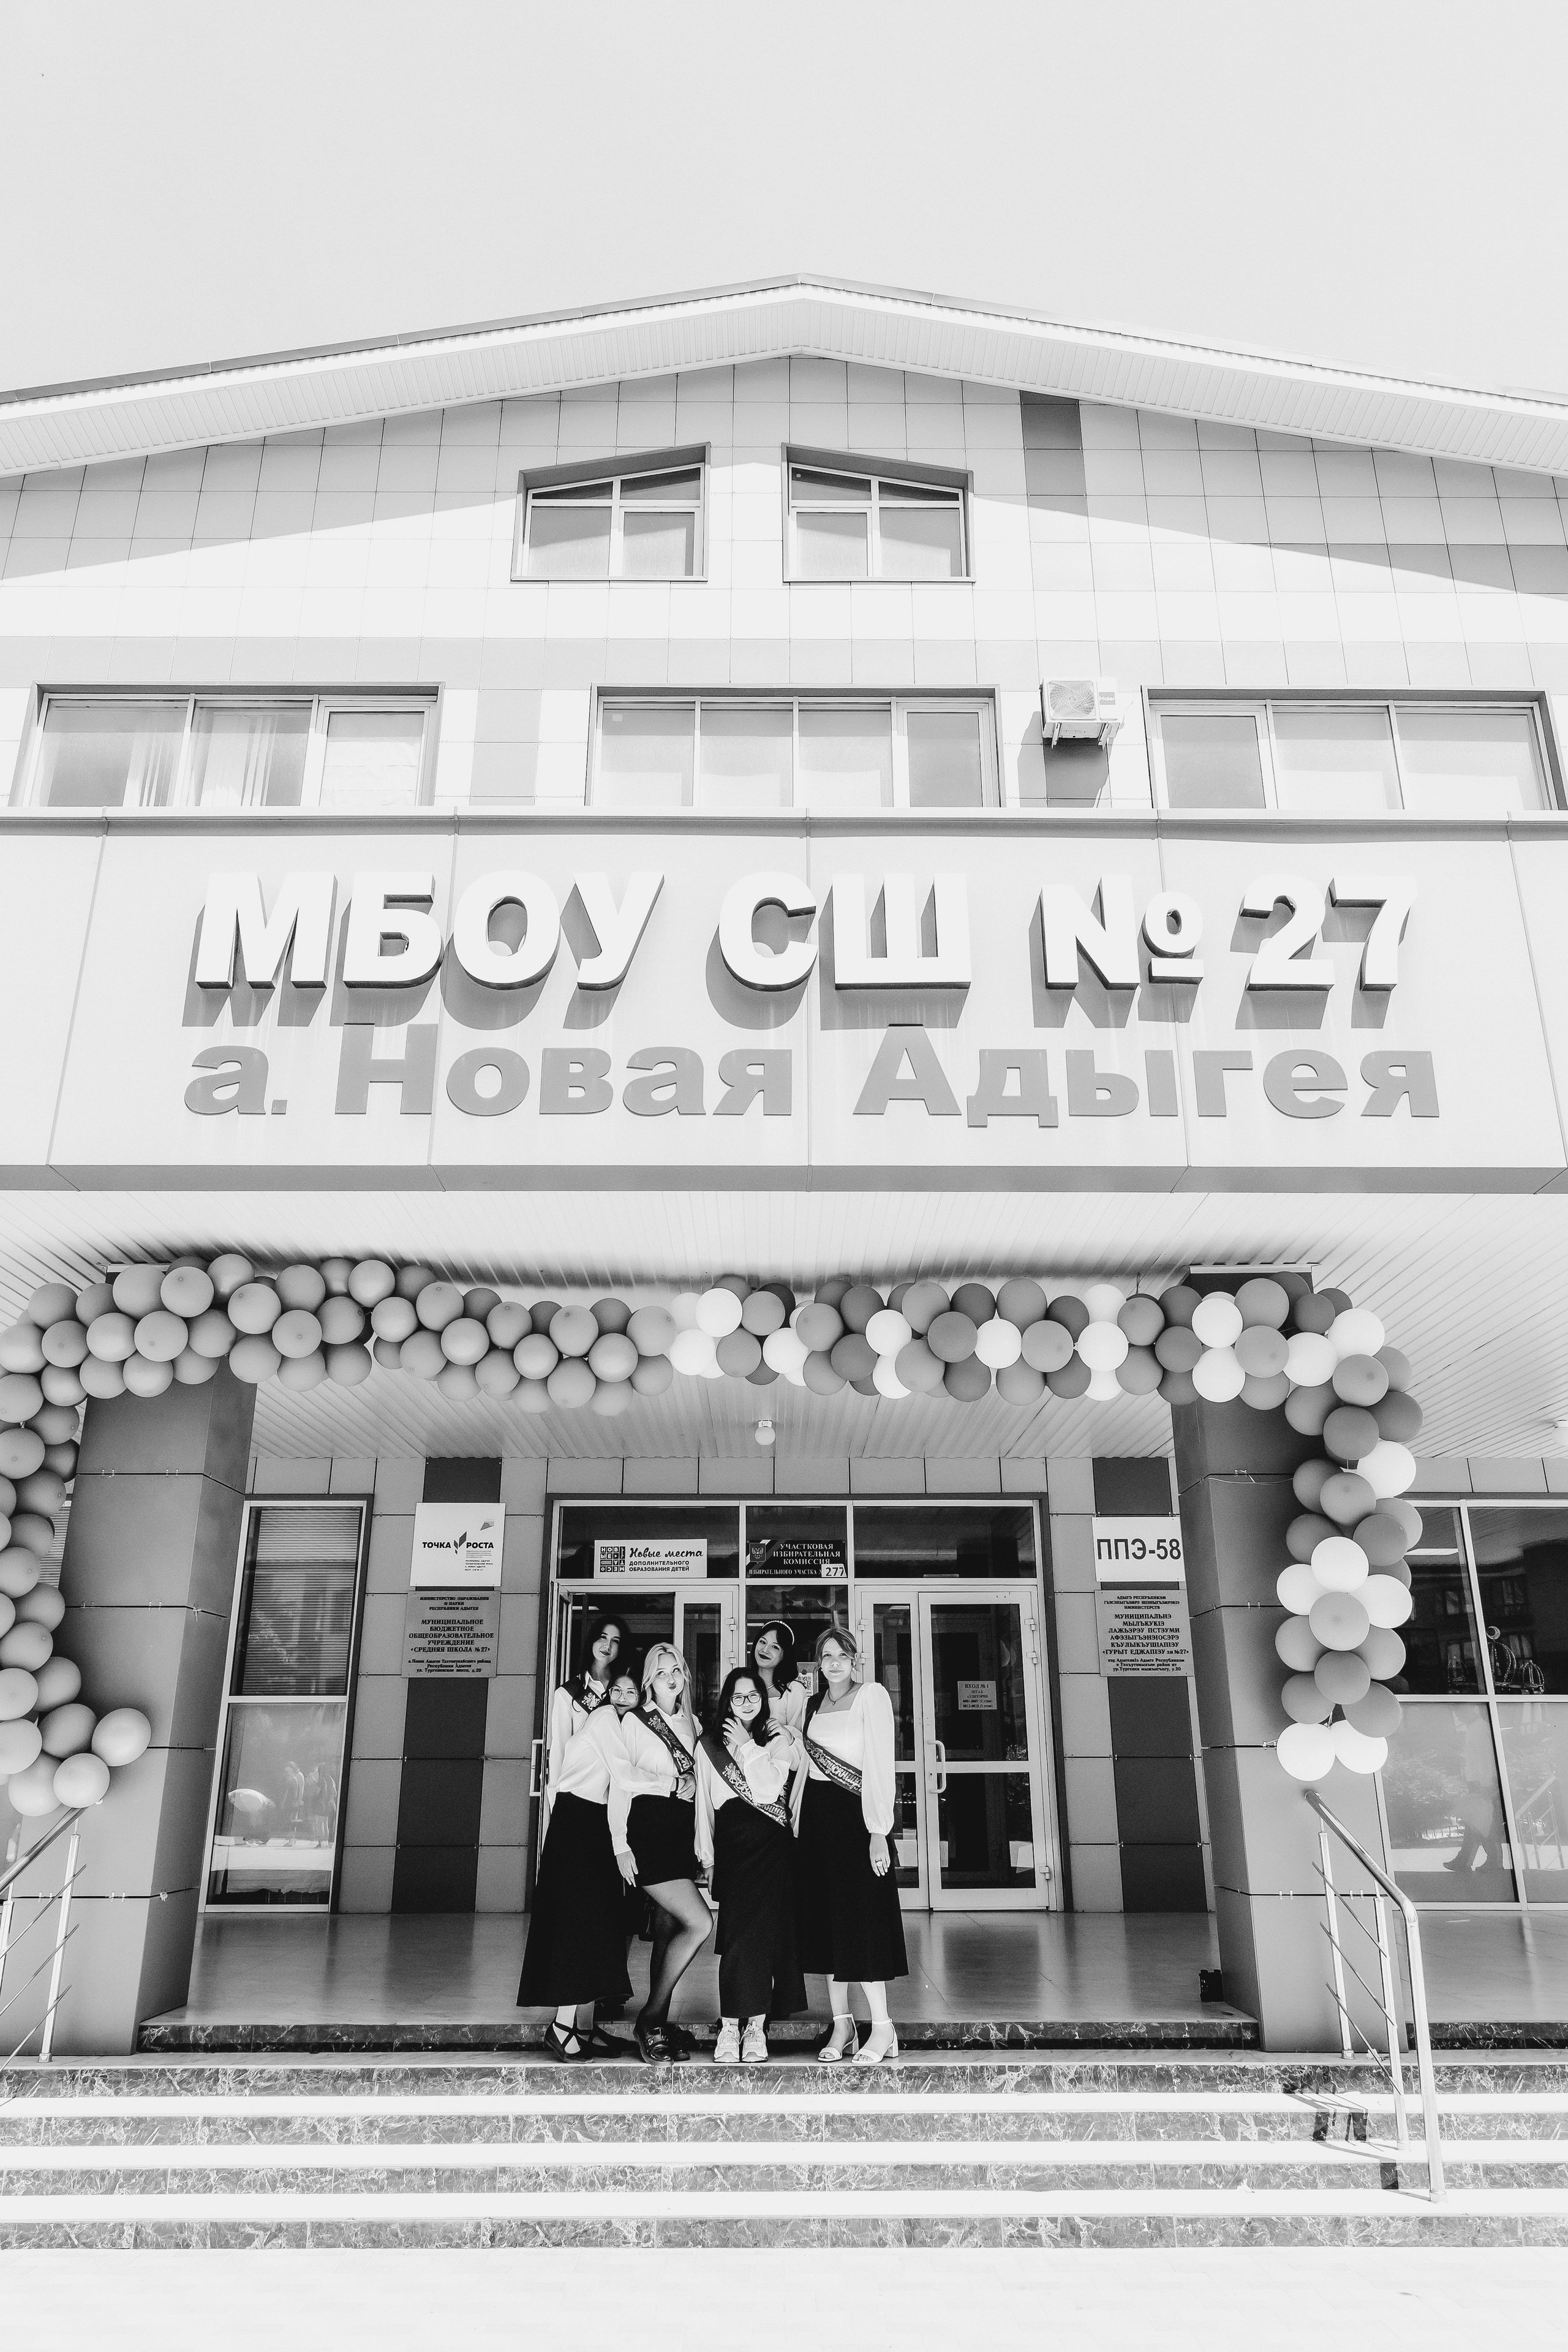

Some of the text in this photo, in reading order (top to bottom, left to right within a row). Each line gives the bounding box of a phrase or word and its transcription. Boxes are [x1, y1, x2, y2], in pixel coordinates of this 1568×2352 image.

[195, 870, 1418, 992] МБОУ СШ № 27
[184, 1023, 1439, 1128] а. Новая Адыгея
[629, 1548, 662, 1558] Новые
[1097, 1539, 1181, 1559] ППЭ-58
[826, 1567, 844, 1576] 277
